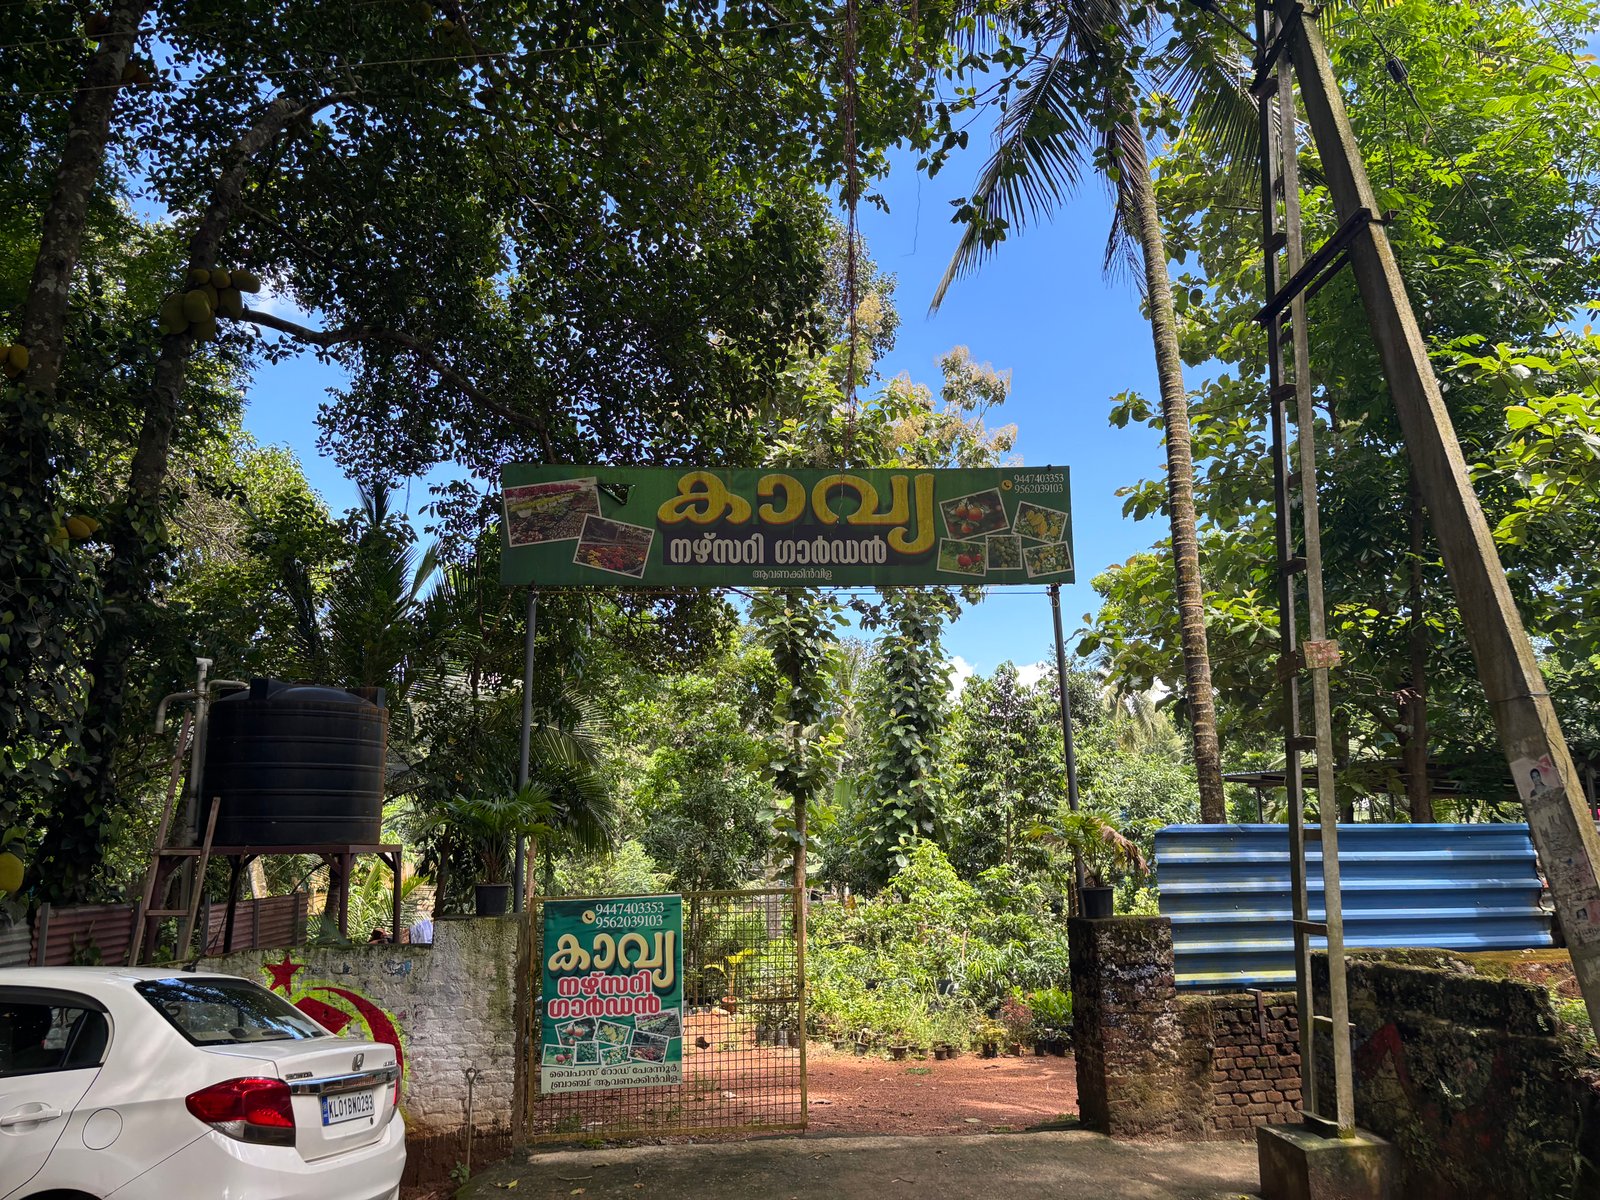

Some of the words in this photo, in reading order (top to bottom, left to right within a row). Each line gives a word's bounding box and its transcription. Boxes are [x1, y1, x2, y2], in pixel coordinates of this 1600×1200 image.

[1014, 473, 1064, 483] 9447403353
[1014, 484, 1063, 493] 9562039103
[657, 471, 935, 555] കാവ്യ
[670, 532, 764, 564] നഴ്സറി
[774, 535, 887, 564] ഗാർഡൻ
[595, 902, 664, 915] 9447403353
[595, 915, 663, 928] 9562039103
[548, 930, 675, 988] കാവ്യ
[558, 969, 652, 996] നഴ്സറി
[548, 993, 661, 1018] ഗാർഡൻ
